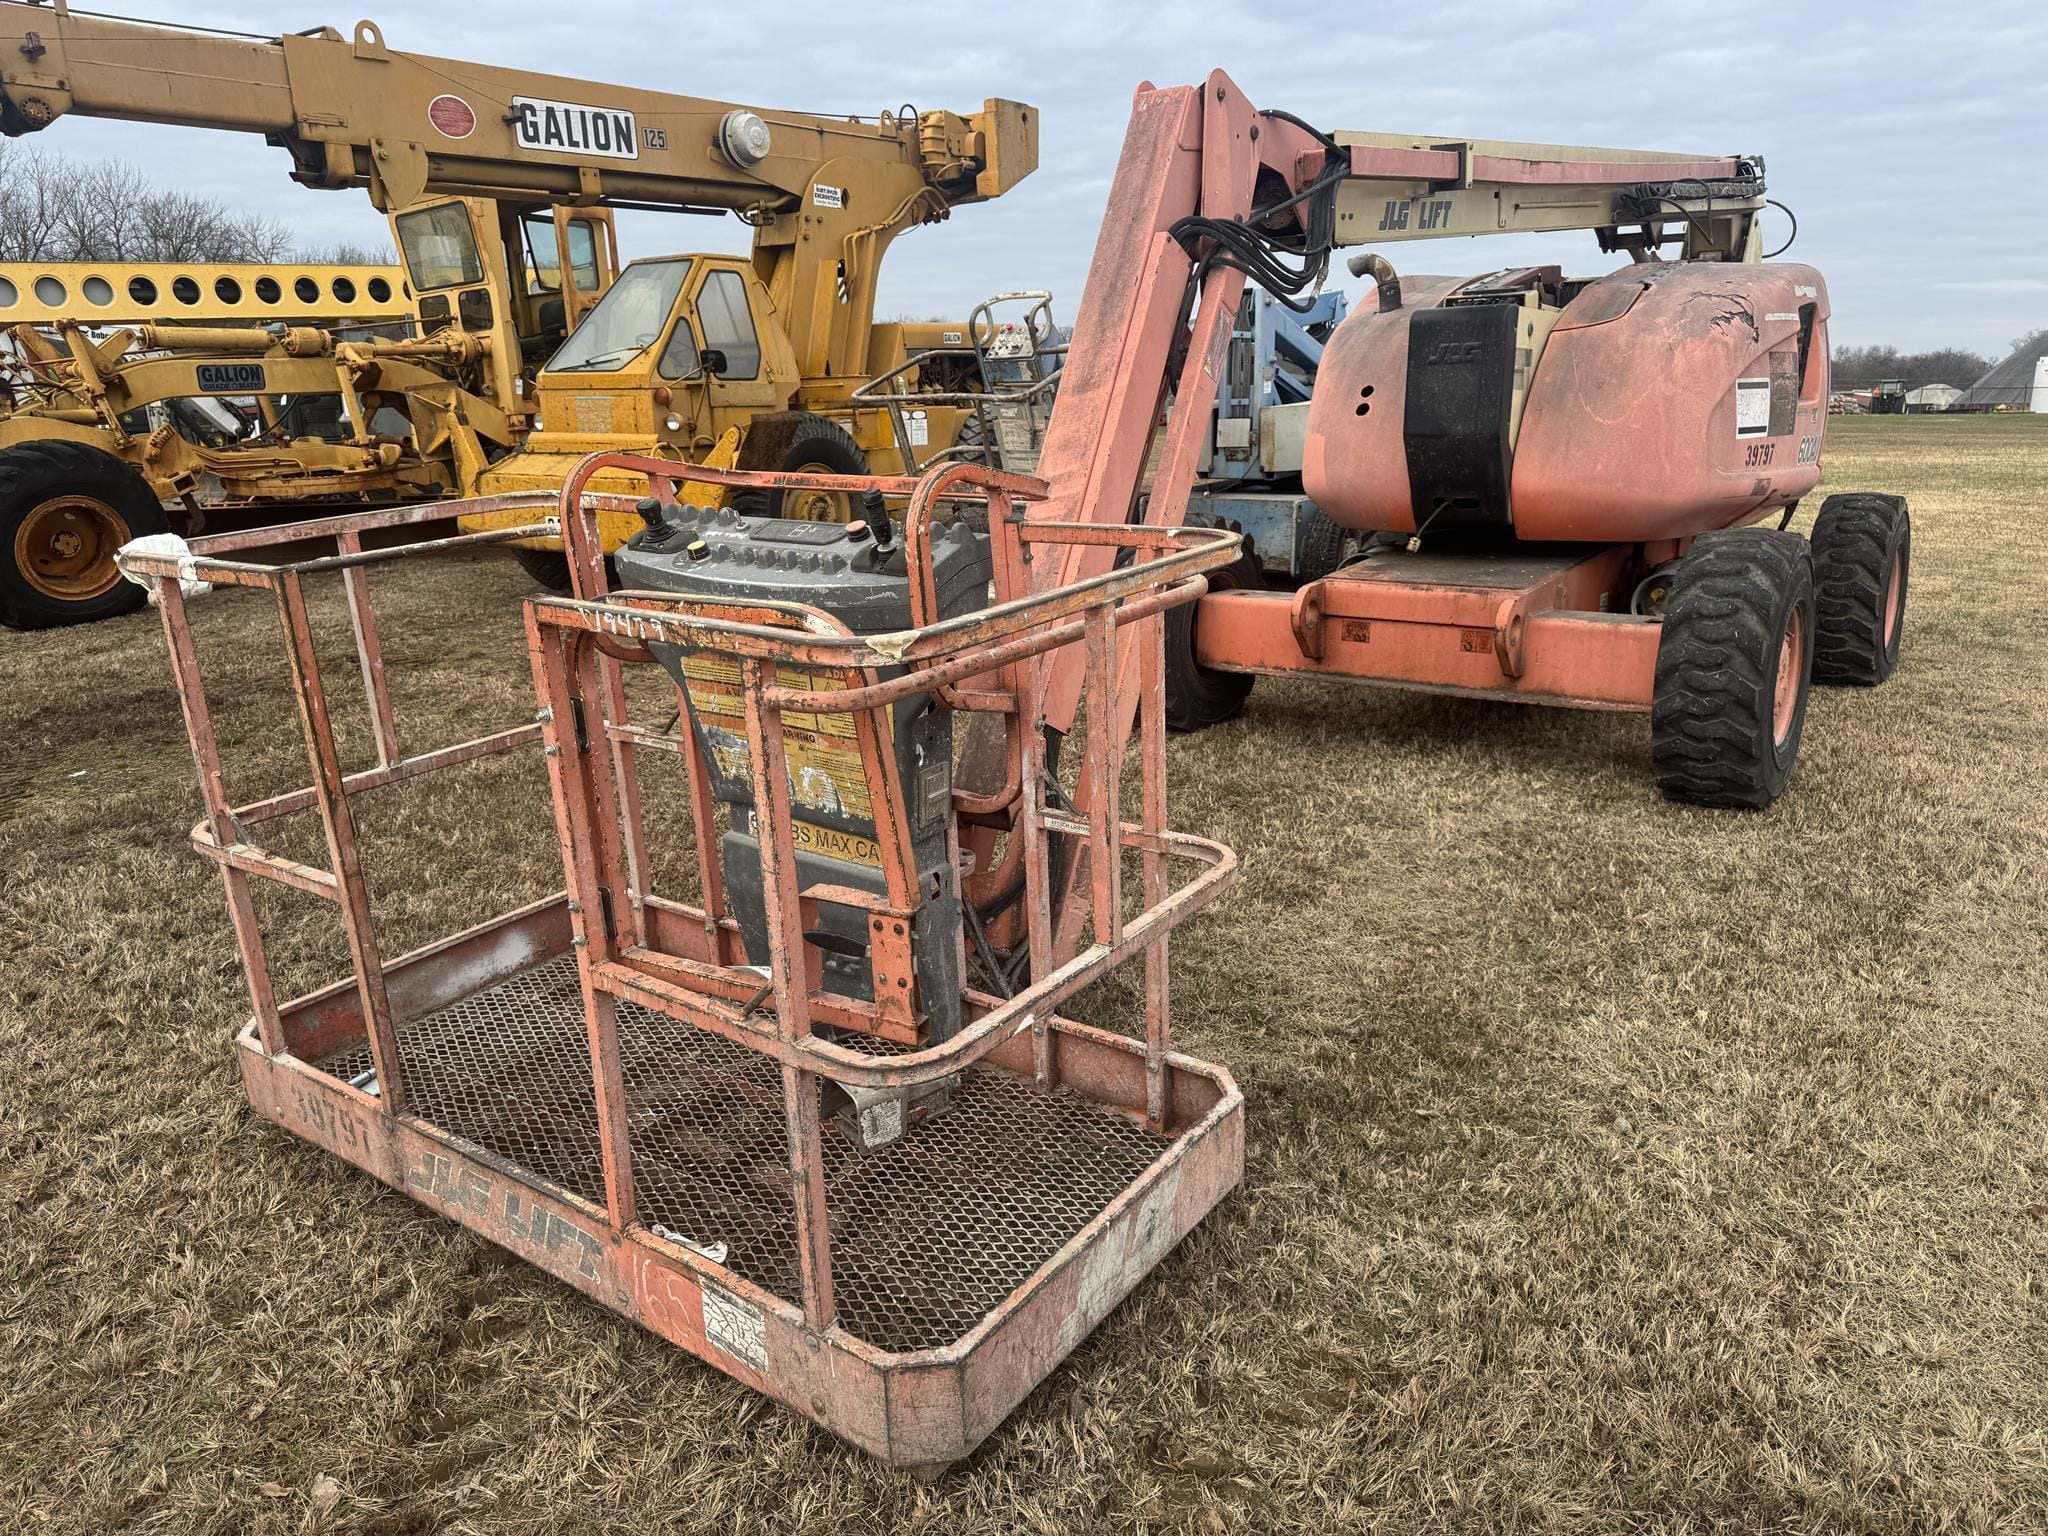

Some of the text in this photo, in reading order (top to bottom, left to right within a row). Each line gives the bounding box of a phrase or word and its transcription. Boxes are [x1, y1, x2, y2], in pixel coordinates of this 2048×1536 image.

[519, 102, 634, 154] GALION
[643, 129, 665, 148] 125
[1378, 200, 1453, 232] JLG LIFT
[91, 330, 111, 340] Bobc
[1427, 341, 1483, 365] JLG
[201, 366, 261, 382] GALION
[1745, 443, 1775, 467] 39797
[783, 729, 816, 743] ARNING
[792, 823, 811, 844] BS
[816, 829, 852, 854] MAX
[291, 1084, 371, 1156] 39797
[408, 1150, 602, 1284] JLG LIFT
